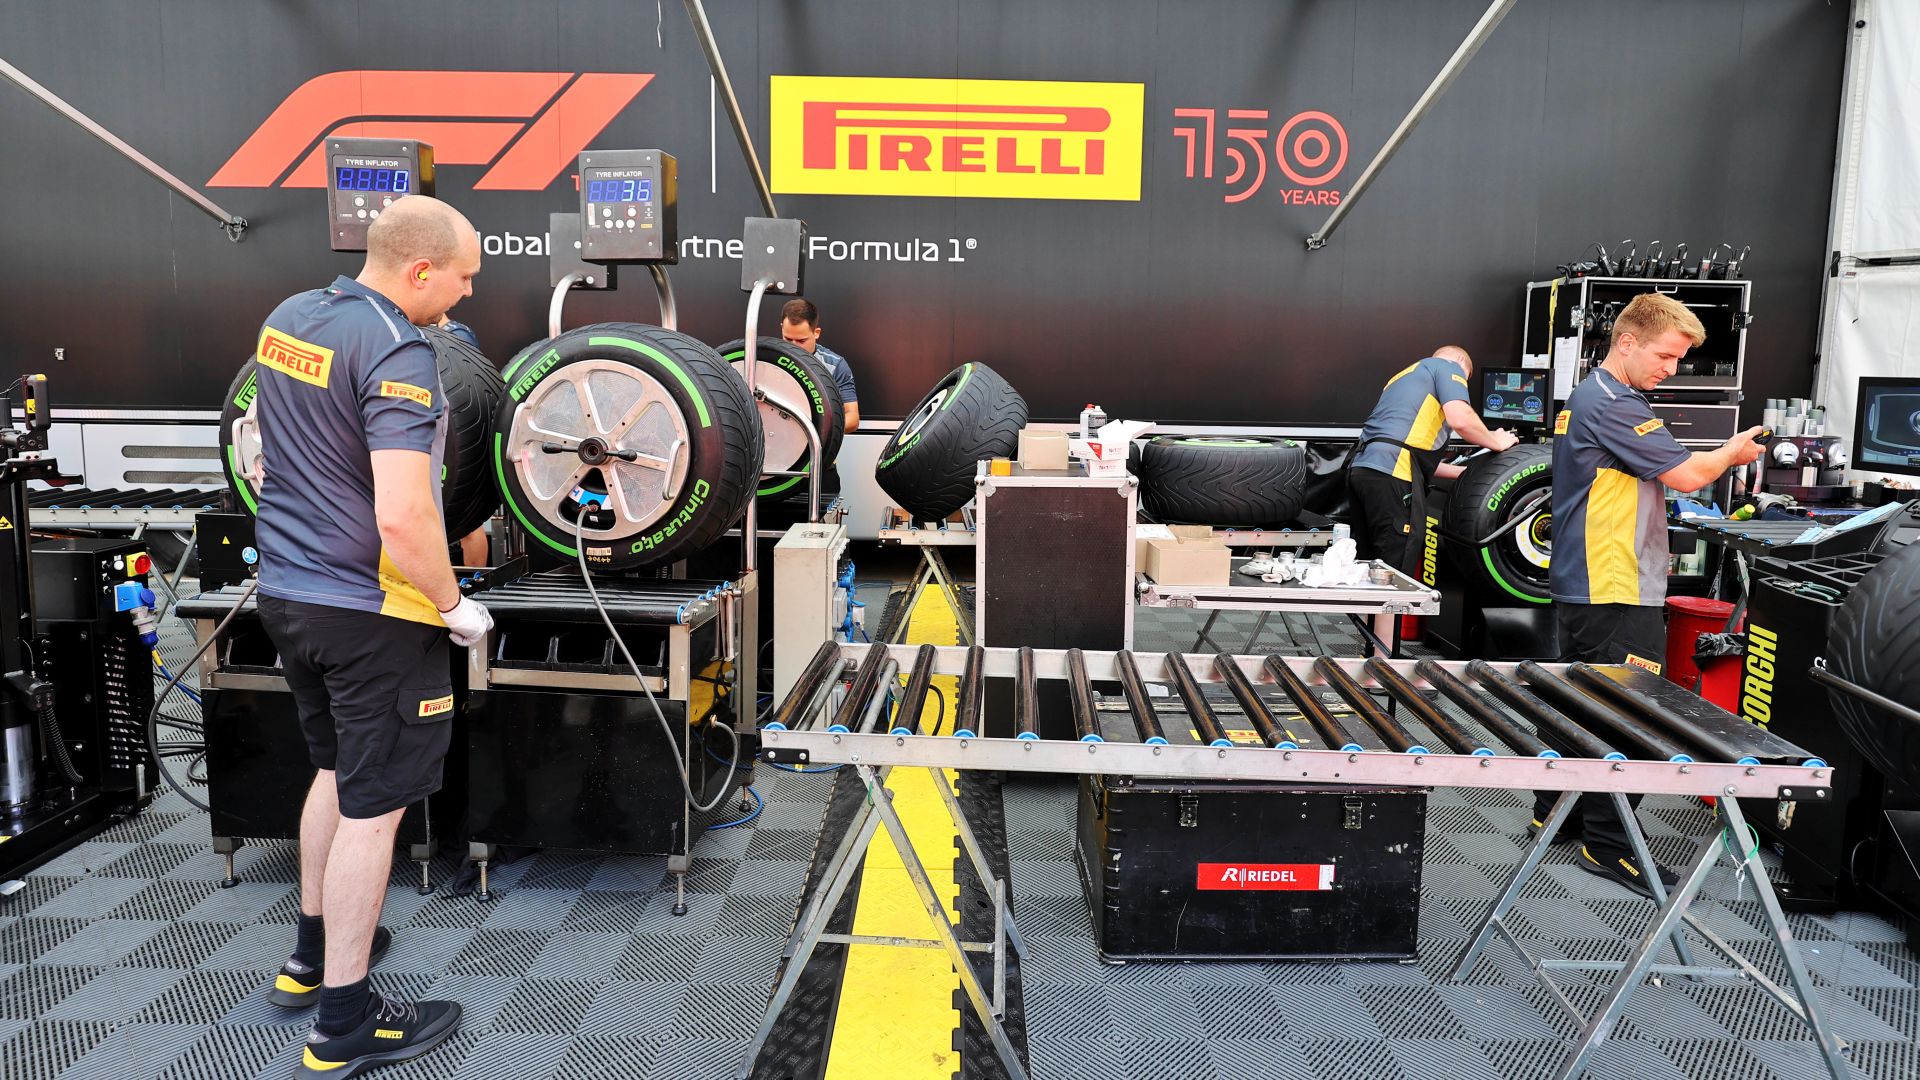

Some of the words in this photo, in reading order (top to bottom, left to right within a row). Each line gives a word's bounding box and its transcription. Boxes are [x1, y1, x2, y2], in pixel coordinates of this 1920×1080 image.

[803, 101, 1111, 175] PIRELLI
[1174, 108, 1349, 203] 150
[365, 159, 399, 167] INFLATOR
[1279, 189, 1341, 206] YEARS
[681, 235, 744, 259] rtne
[808, 236, 939, 262] Formula
[262, 335, 324, 378] PIRELLI
[509, 348, 561, 402] PIRELLI
[777, 356, 824, 414] Cinturato
[1487, 462, 1546, 512] Cinturato
[628, 478, 710, 554] Cinturato
[424, 698, 452, 713] PIRELLI
[1248, 870, 1297, 882] RIEDEL
